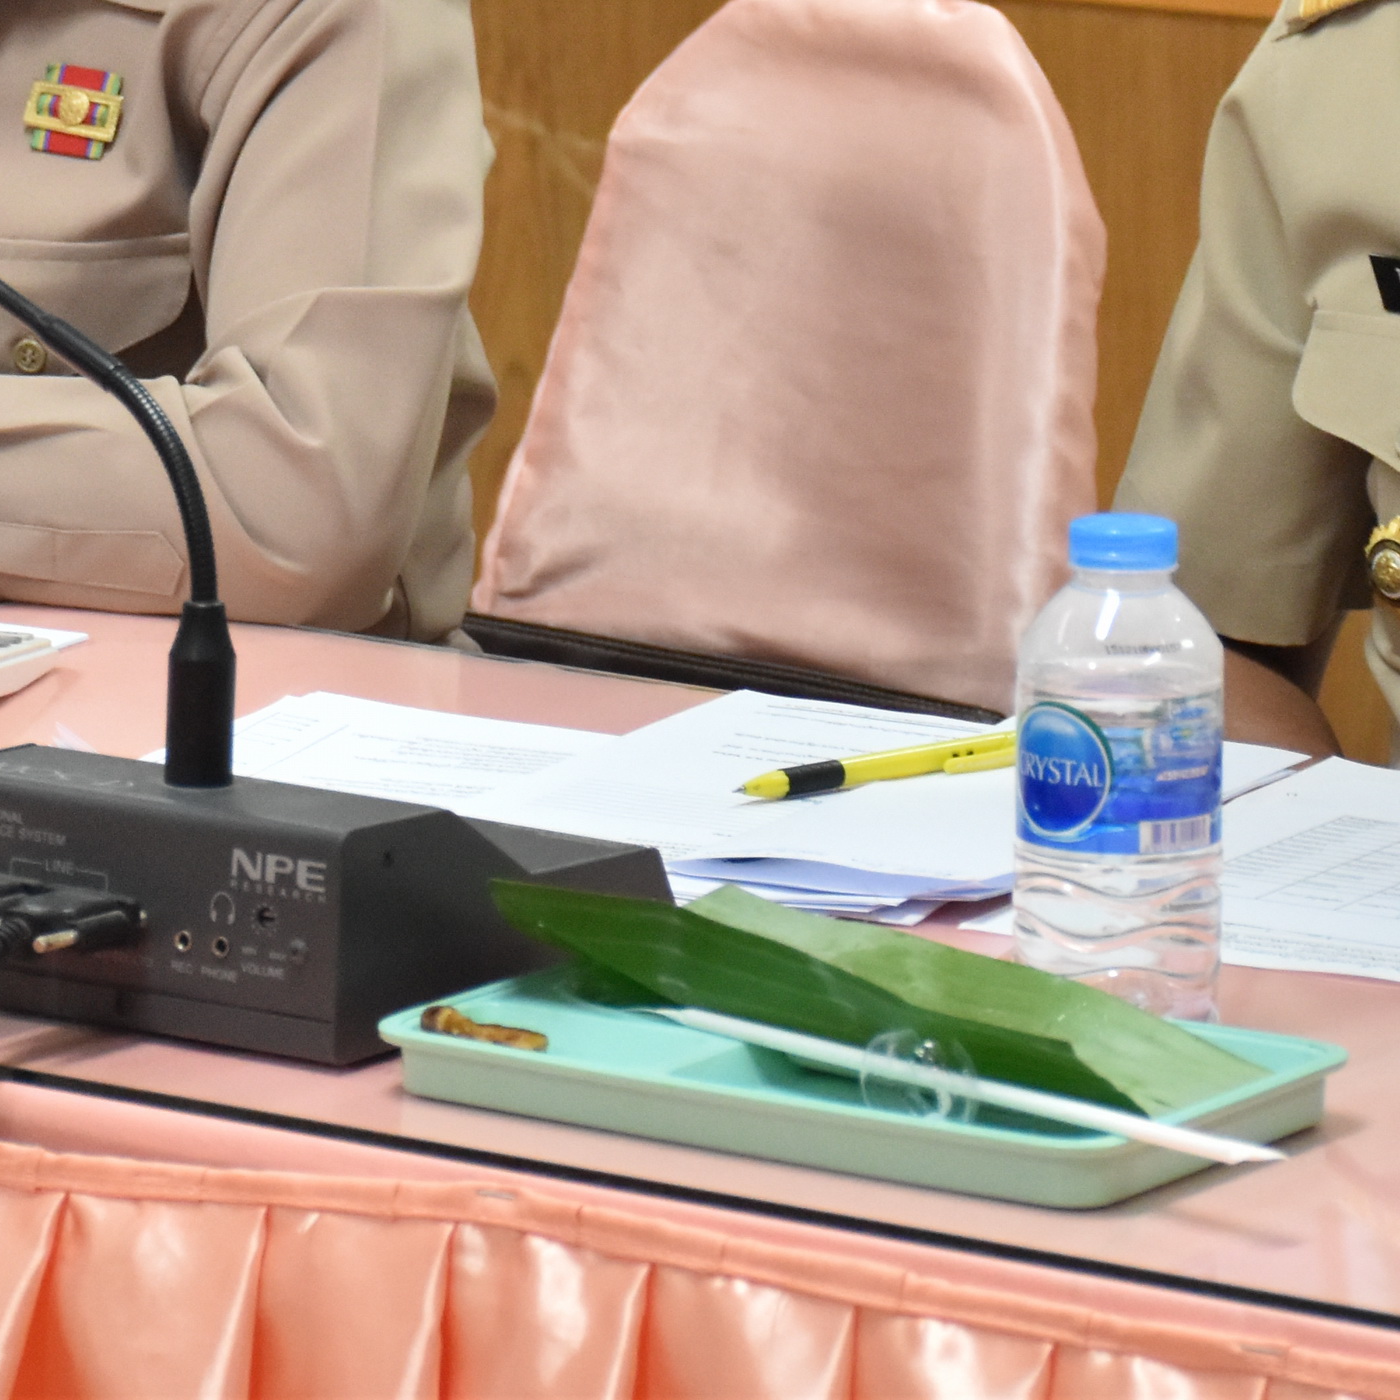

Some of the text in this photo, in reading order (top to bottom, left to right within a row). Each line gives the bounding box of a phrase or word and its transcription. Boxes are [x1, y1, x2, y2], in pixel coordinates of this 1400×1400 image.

[18, 827, 67, 846] SYSTEM
[45, 858, 77, 877] LINE
[231, 847, 327, 894] NPE
[240, 961, 286, 980] VOLUME
